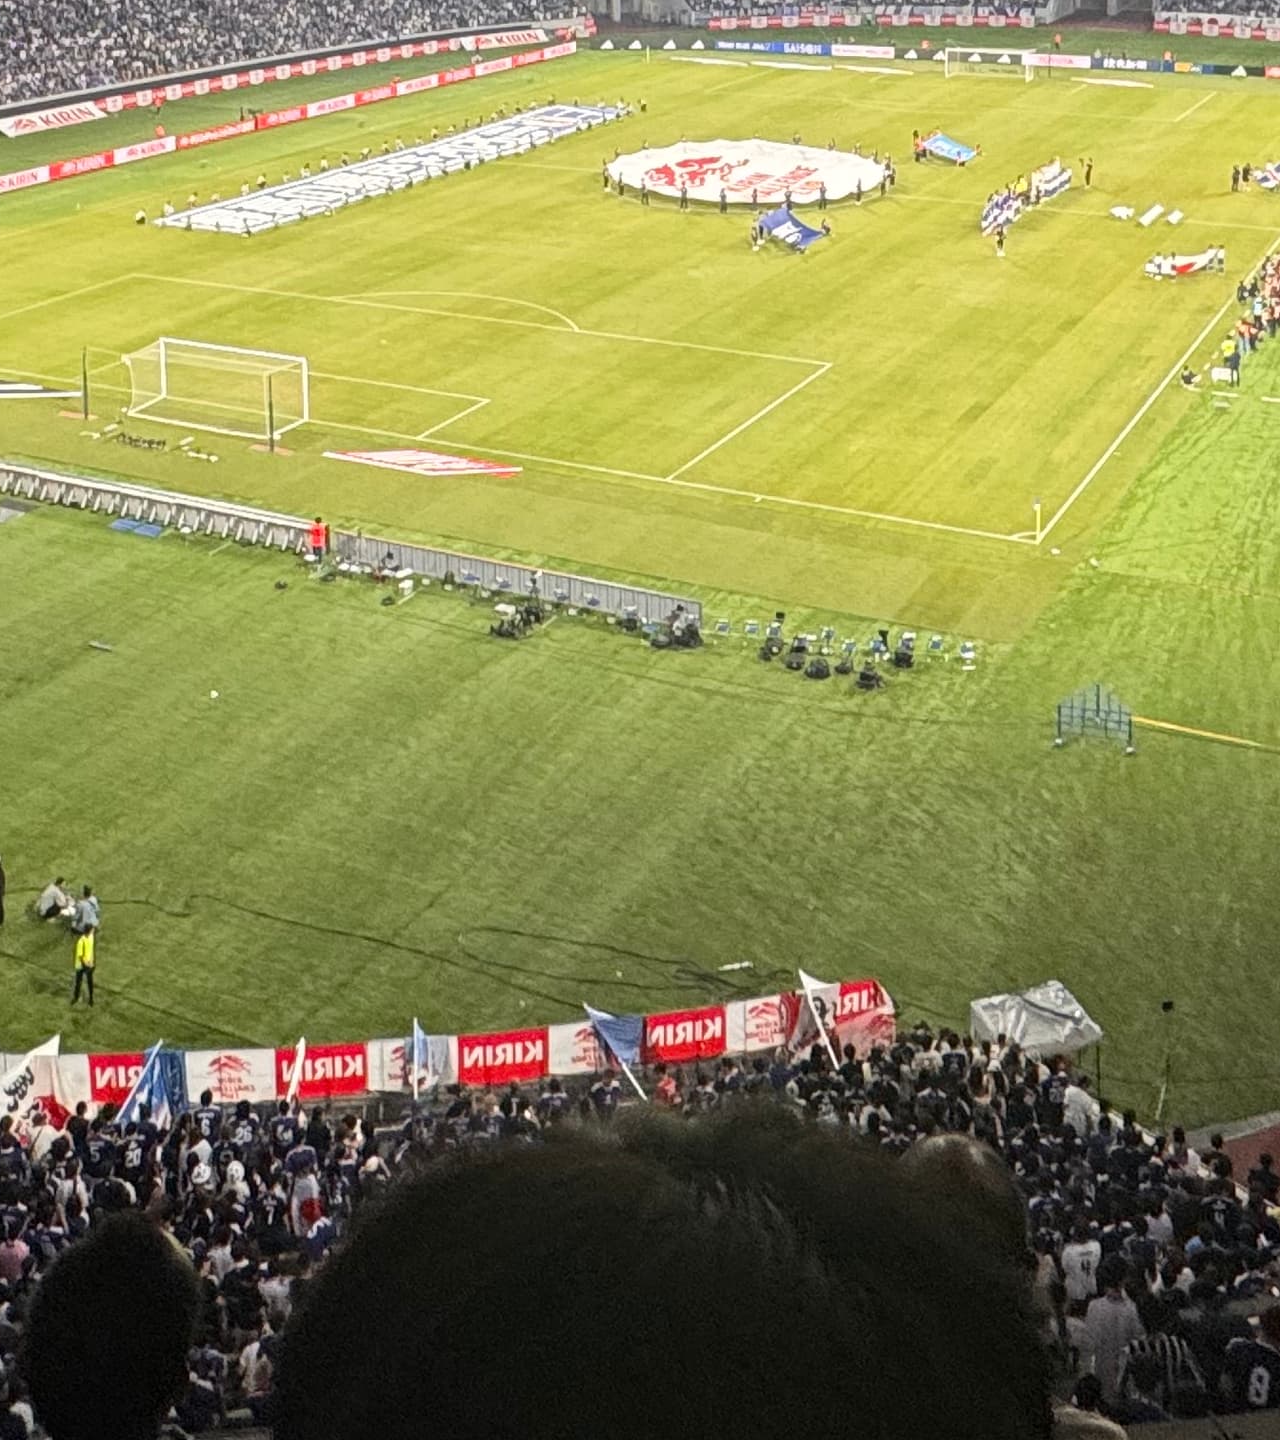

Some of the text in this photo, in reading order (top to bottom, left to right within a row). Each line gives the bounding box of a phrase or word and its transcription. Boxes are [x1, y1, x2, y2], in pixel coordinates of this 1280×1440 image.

[38, 105, 96, 128] KIRIN
[8, 171, 39, 188] KIRIN
[200, 1118, 210, 1137] 6
[90, 1146, 101, 1162] 5
[124, 1147, 142, 1168] 20
[1248, 1365, 1271, 1407] 8
